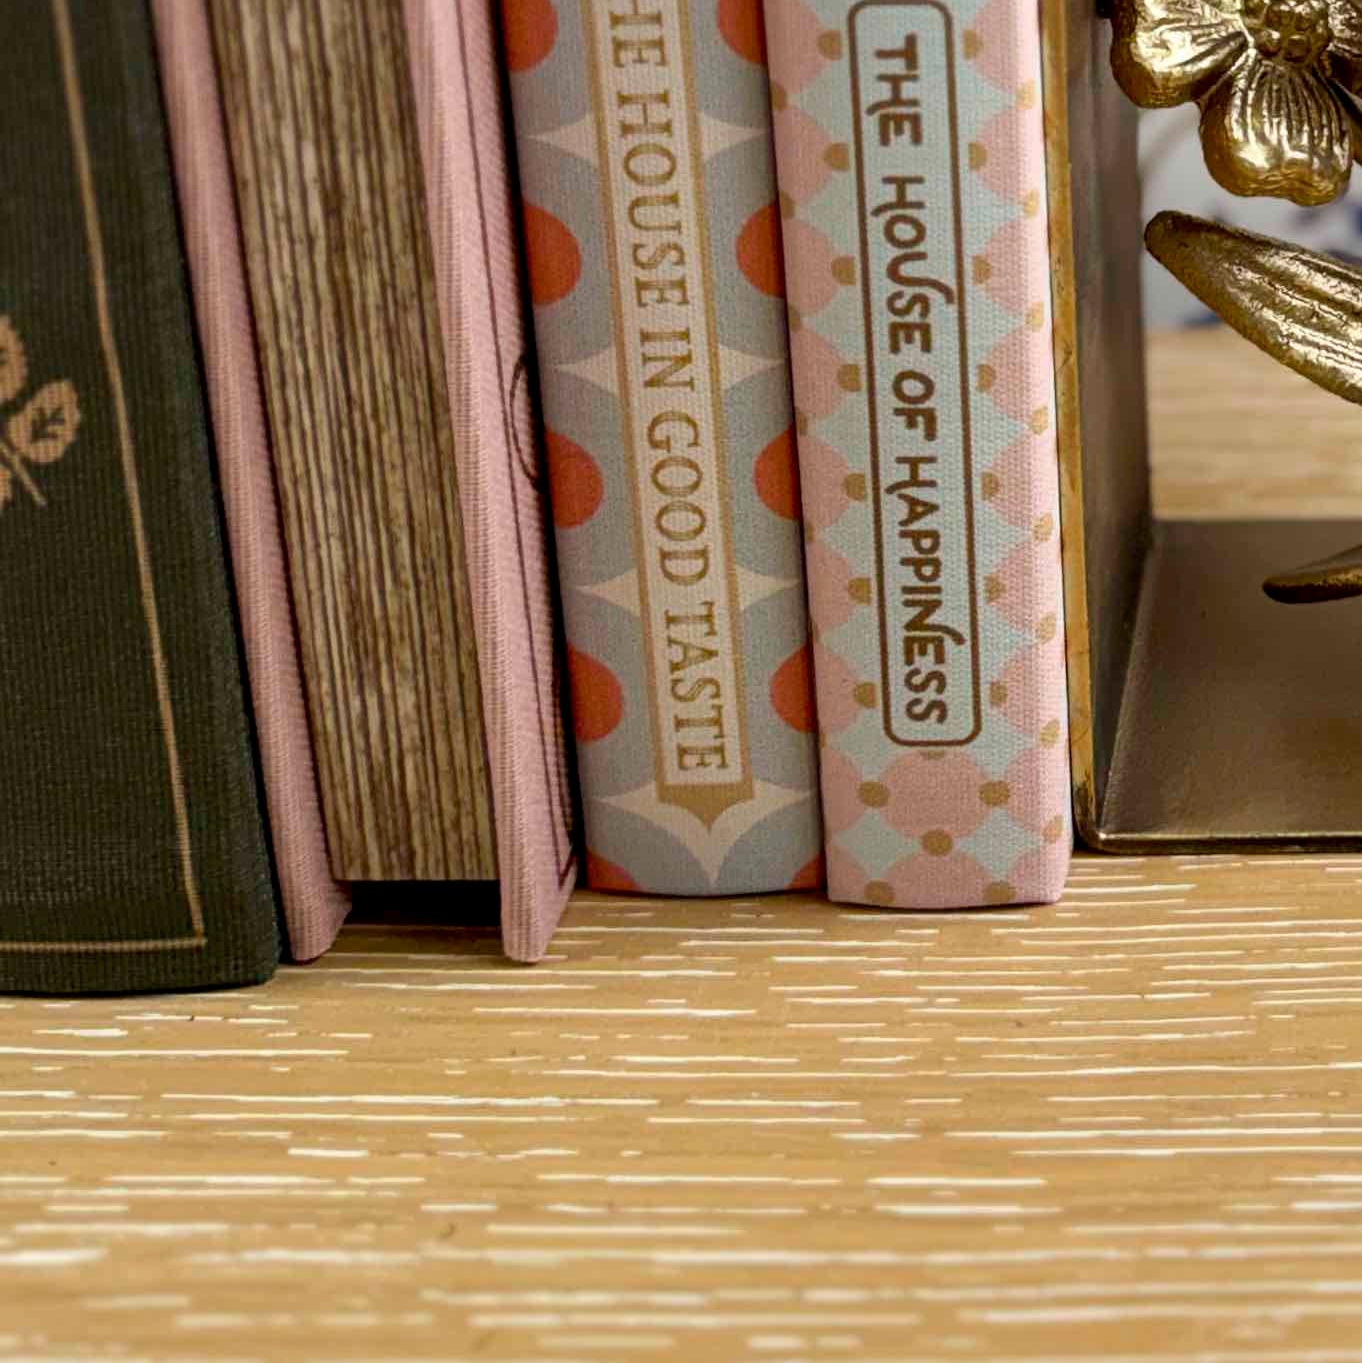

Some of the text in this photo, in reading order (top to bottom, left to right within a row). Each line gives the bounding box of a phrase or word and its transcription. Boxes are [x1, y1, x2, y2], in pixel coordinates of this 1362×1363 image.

[617, 88, 691, 309] HOUSE
[639, 328, 696, 393] IN
[865, 32, 967, 726] THE HOUSE OF HAPPINESS
[646, 410, 709, 587] GOOD
[664, 601, 730, 773] TASTE
